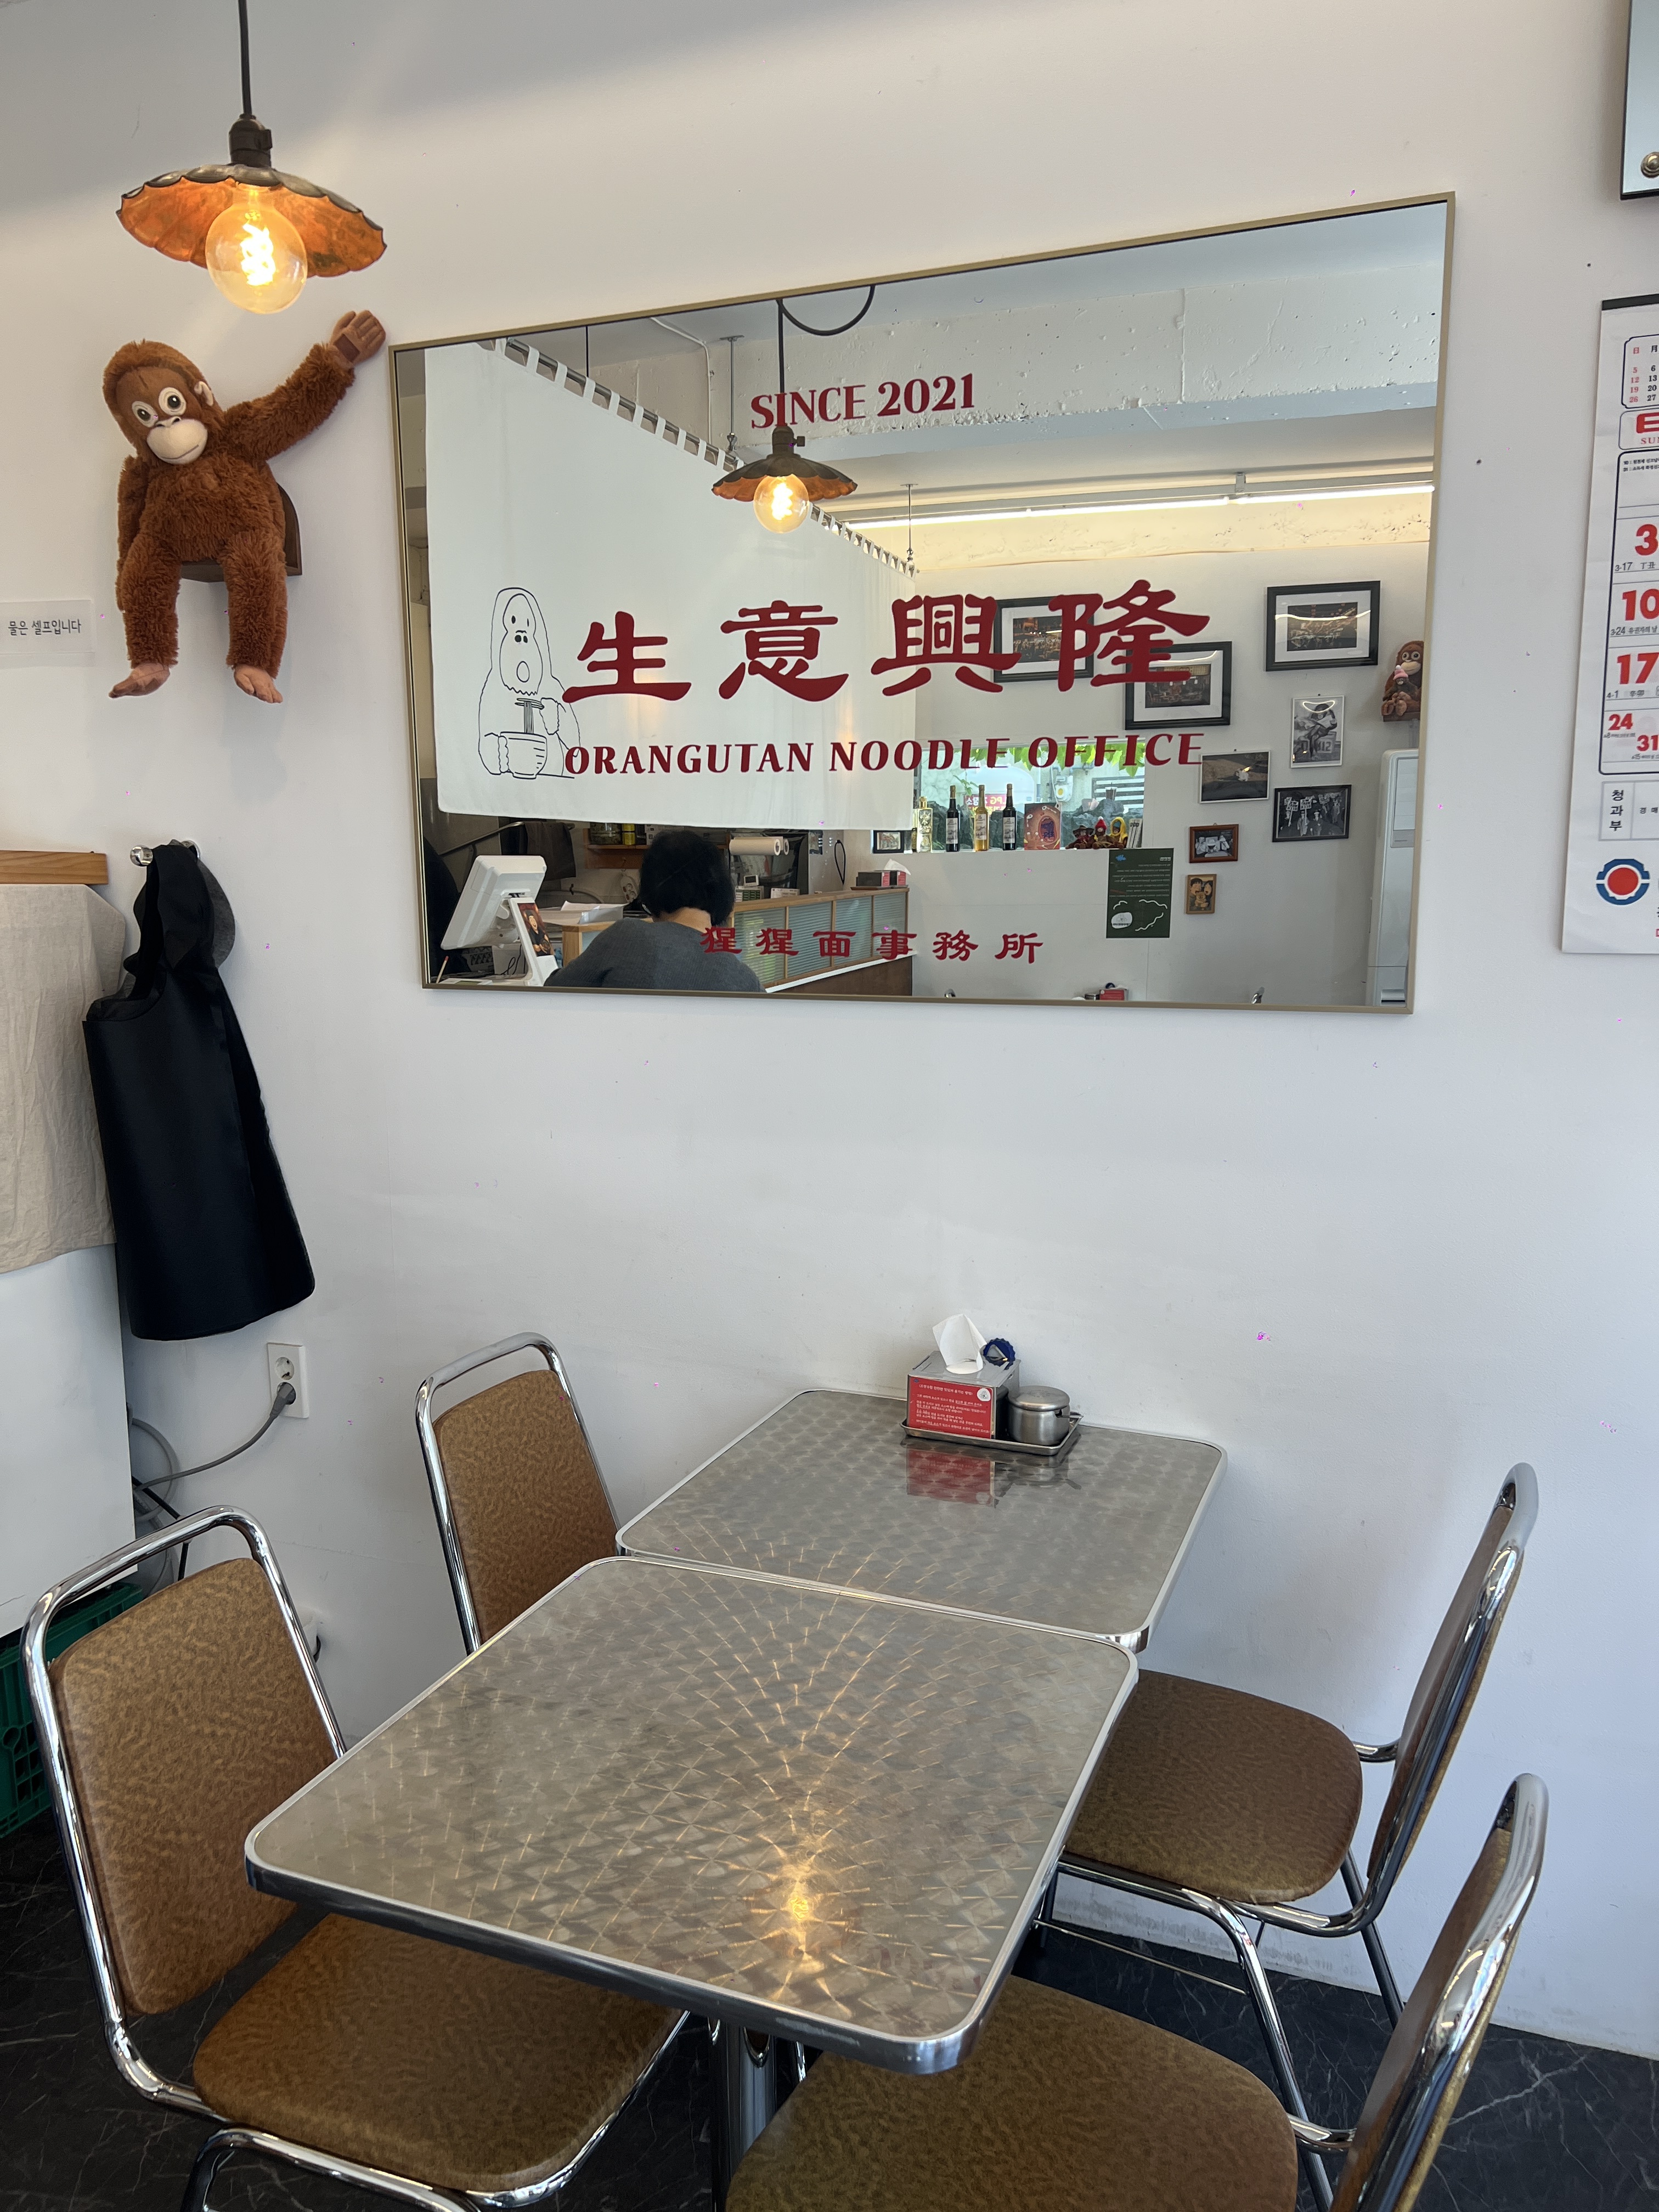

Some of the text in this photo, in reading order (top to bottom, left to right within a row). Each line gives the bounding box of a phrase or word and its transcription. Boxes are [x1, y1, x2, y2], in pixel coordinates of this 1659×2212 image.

[1651, 345, 1658, 353] 月
[751, 373, 974, 428] SINCE 2021
[1635, 524, 1658, 556] 3
[1622, 588, 1659, 620] 10
[8, 619, 81, 636] 물은 셀프입니다
[1617, 652, 1659, 685] 17
[1607, 713, 1633, 731] 24
[565, 733, 1205, 774] ORANGUTAN NOODLE OFFICE
[1636, 735, 1659, 752] 31
